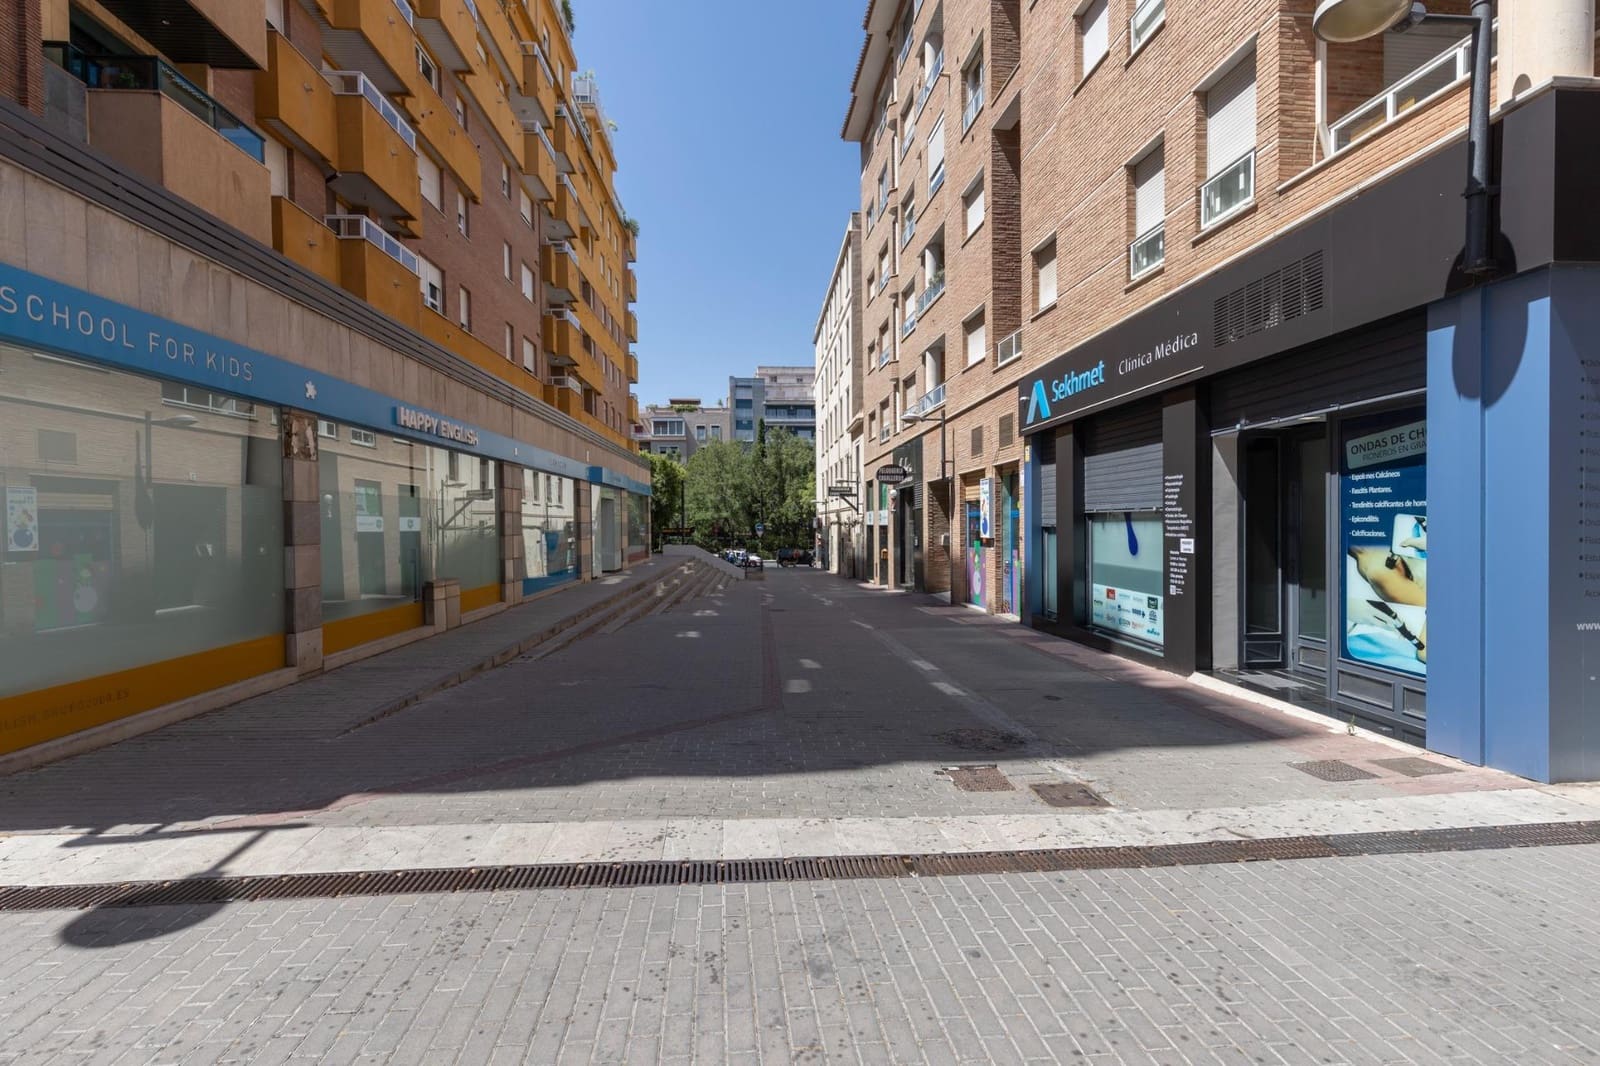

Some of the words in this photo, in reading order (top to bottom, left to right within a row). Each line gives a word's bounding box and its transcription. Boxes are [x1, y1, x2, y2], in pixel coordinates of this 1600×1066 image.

[0, 286, 135, 348] SCHOOL
[149, 332, 195, 366] FOR
[206, 349, 253, 381] KIDS
[1118, 353, 1152, 375] Clínica
[1155, 332, 1198, 361] Médica
[1051, 360, 1105, 403] Sekhmet
[400, 406, 438, 435] HAPPY
[441, 420, 479, 446] ENGLISH
[1351, 437, 1388, 455] ONDAS
[1391, 432, 1406, 445] DE
